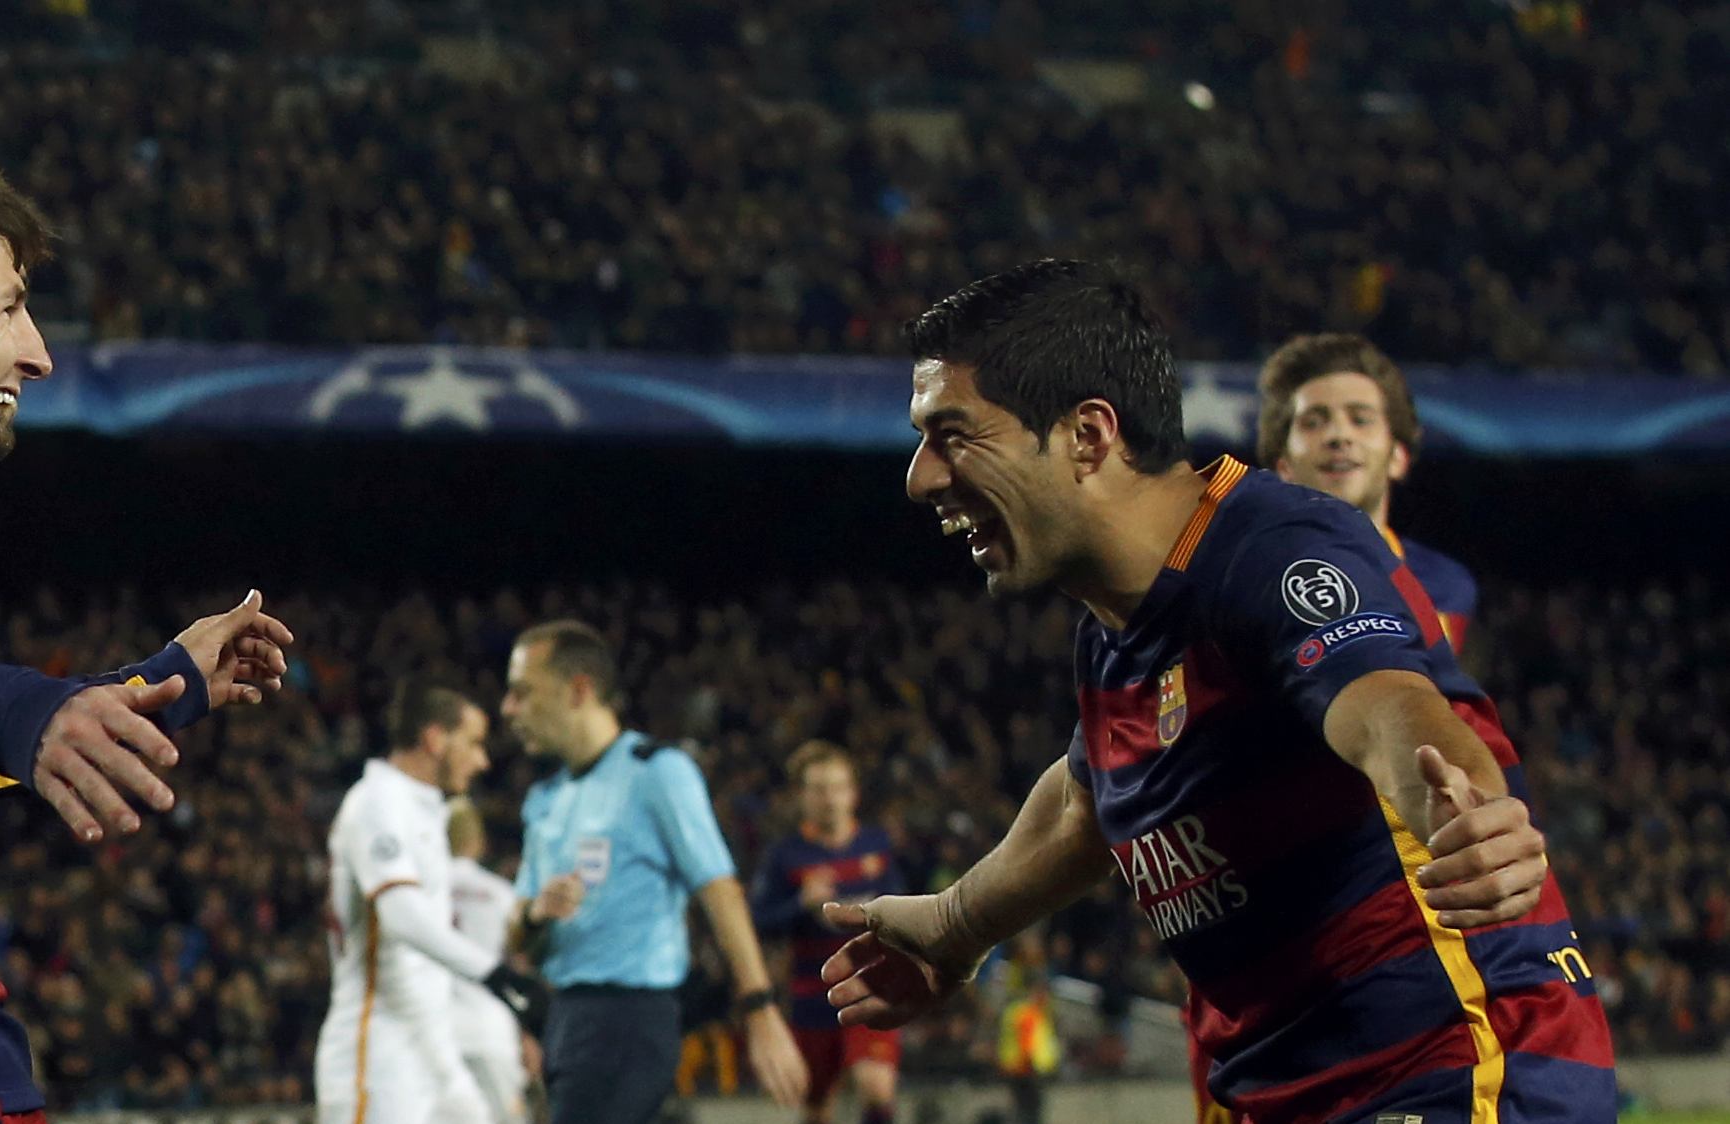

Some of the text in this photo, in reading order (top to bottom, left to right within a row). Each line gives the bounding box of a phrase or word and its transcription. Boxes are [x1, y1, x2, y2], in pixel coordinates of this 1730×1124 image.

[1314, 588, 1335, 608] 5
[1322, 618, 1403, 646] RESPECT
[1110, 814, 1229, 901] ATAR
